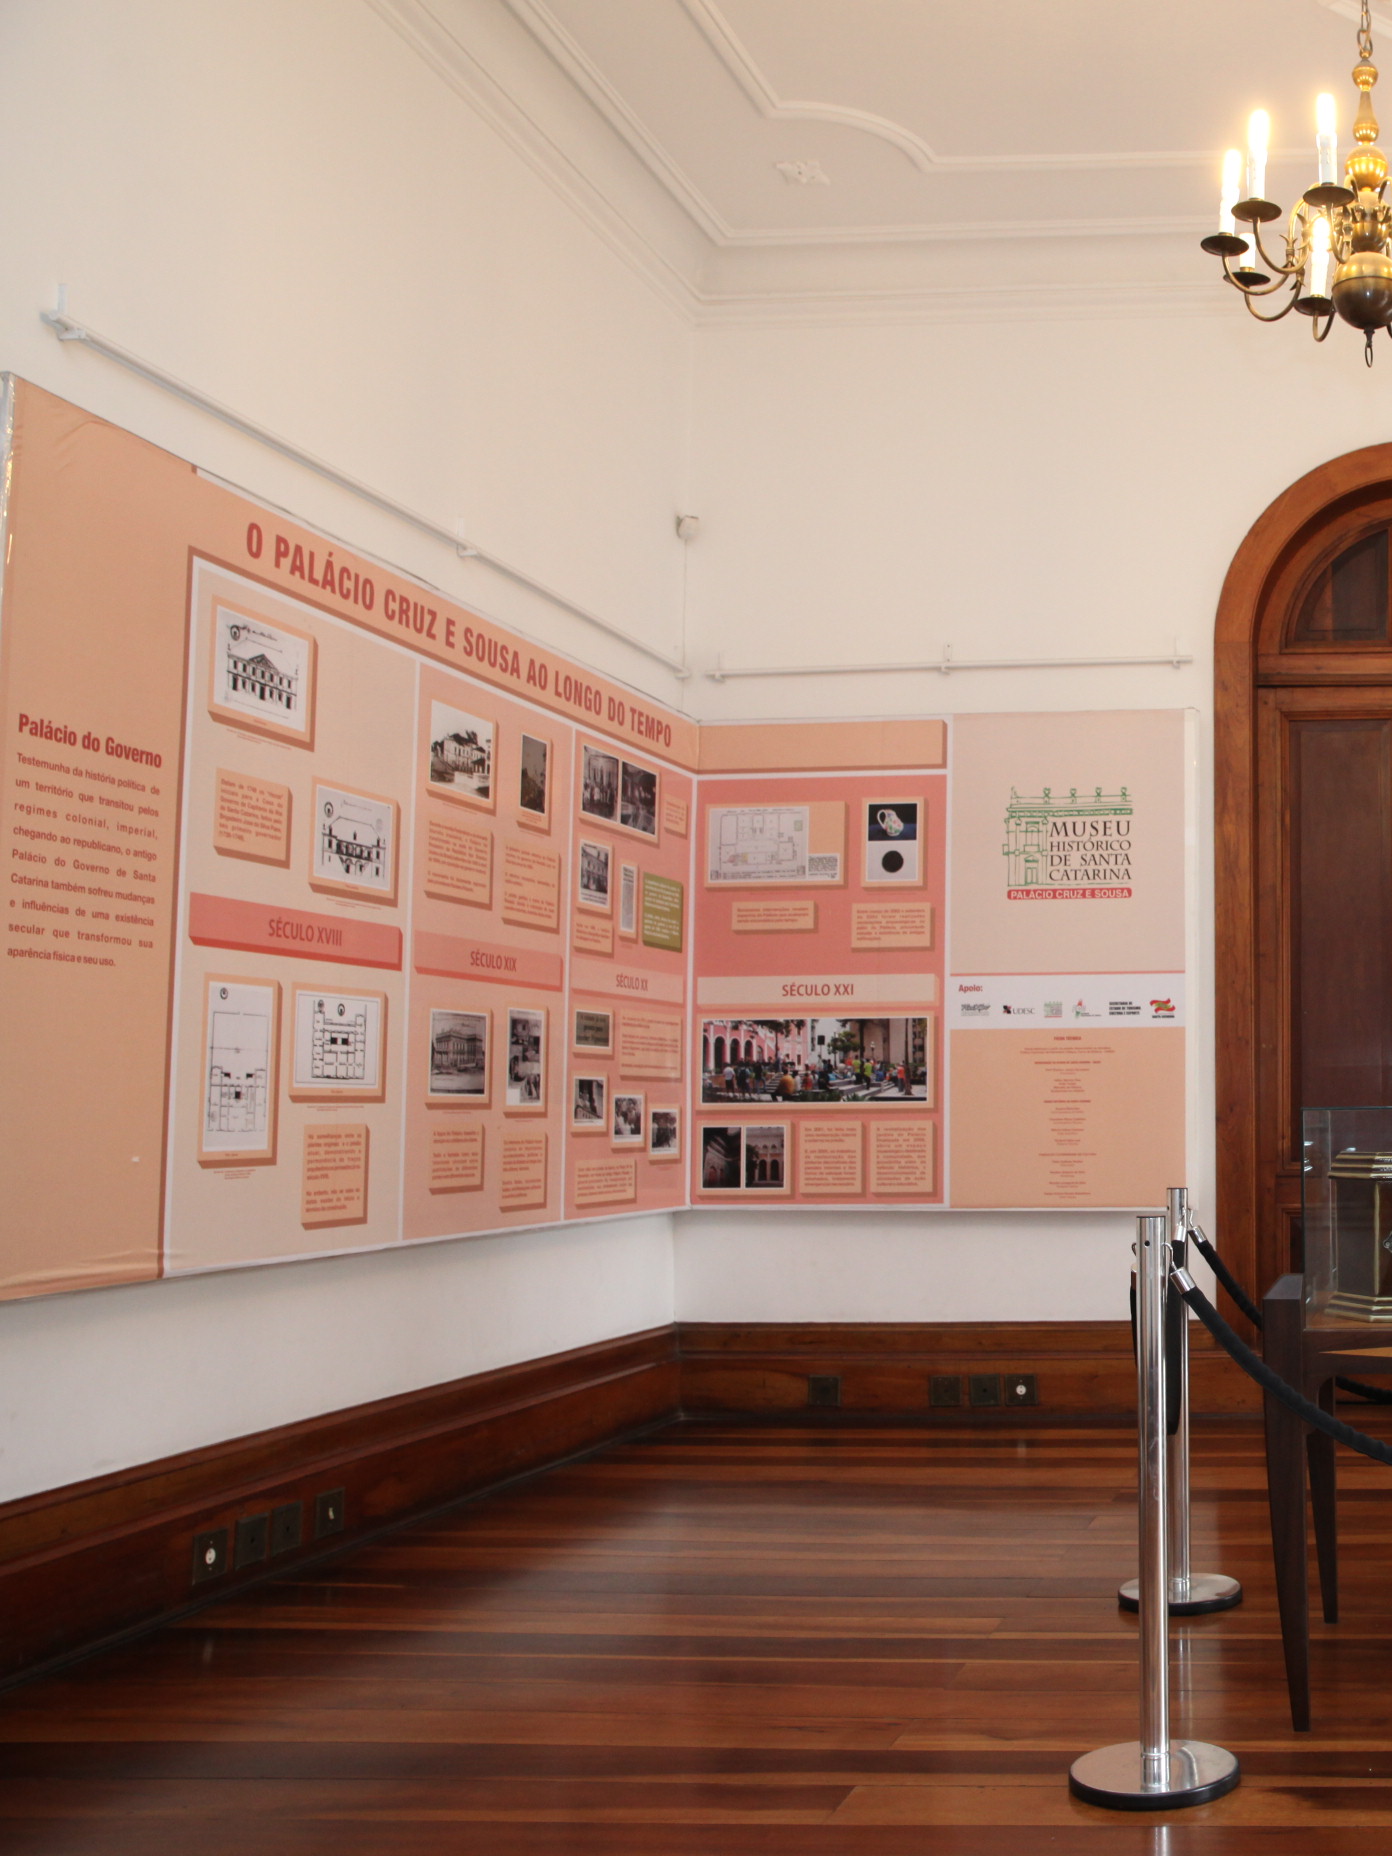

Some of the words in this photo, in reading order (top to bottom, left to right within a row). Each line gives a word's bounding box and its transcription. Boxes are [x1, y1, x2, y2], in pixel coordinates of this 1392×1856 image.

[247, 523, 263, 559] O
[274, 534, 374, 611] PALÁCIO
[384, 589, 437, 641] CRUZ
[445, 617, 455, 649] E
[463, 627, 521, 679] SOUSA
[527, 658, 548, 691] AO
[554, 670, 602, 716] LONGO
[608, 696, 625, 726] DO
[630, 707, 671, 748] TEMPO
[19, 713, 77, 746] Palácio
[82, 732, 100, 752] do
[105, 737, 162, 768] Governo
[17, 752, 70, 775] Testemunha
[72, 767, 83, 777] da
[85, 769, 115, 785] história
[117, 778, 145, 792] política
[150, 786, 160, 795] de
[16, 778, 30, 789] um
[35, 782, 73, 798] território
[78, 792, 94, 803] que
[99, 796, 134, 811] transitou
[138, 806, 159, 817] pelos
[14, 802, 58, 818] regimes
[1049, 820, 1130, 837] MUSEU
[13, 826, 57, 842] chegando
[60, 836, 70, 845] ao
[126, 848, 131, 856] o
[133, 849, 157, 863] antigo
[1050, 837, 1131, 852] HISTÓRICO
[12, 849, 46, 864] Palácio
[54, 857, 66, 867] do
[73, 860, 109, 874] Governo
[116, 868, 126, 877] de
[133, 870, 156, 882] Santa
[1050, 854, 1071, 866] DE
[1080, 853, 1131, 866] SANTA
[1049, 869, 1132, 881] CATARINA
[11, 873, 49, 888] Catarina
[51, 880, 86, 893] também
[88, 886, 113, 898] sofreu
[115, 892, 155, 905] mudanças
[1056, 890, 1083, 898] CRUZ
[1095, 889, 1129, 897] SOUSA
[22, 899, 69, 915] influências
[75, 907, 86, 917] de
[92, 912, 109, 920] uma
[115, 913, 154, 926] existência
[9, 923, 45, 935] secular
[53, 928, 70, 939] que
[78, 931, 132, 946] transformou
[139, 939, 153, 948] sua
[268, 917, 315, 942] SÉCULO
[317, 926, 342, 946] XVIII
[470, 949, 503, 970] SÉCULO
[503, 955, 517, 972] XIX
[616, 973, 639, 990] SÉCULO
[640, 978, 649, 992] XX
[782, 981, 830, 997] SÉCULO
[834, 984, 854, 996] XXI
[958, 984, 983, 993] Apoio:
